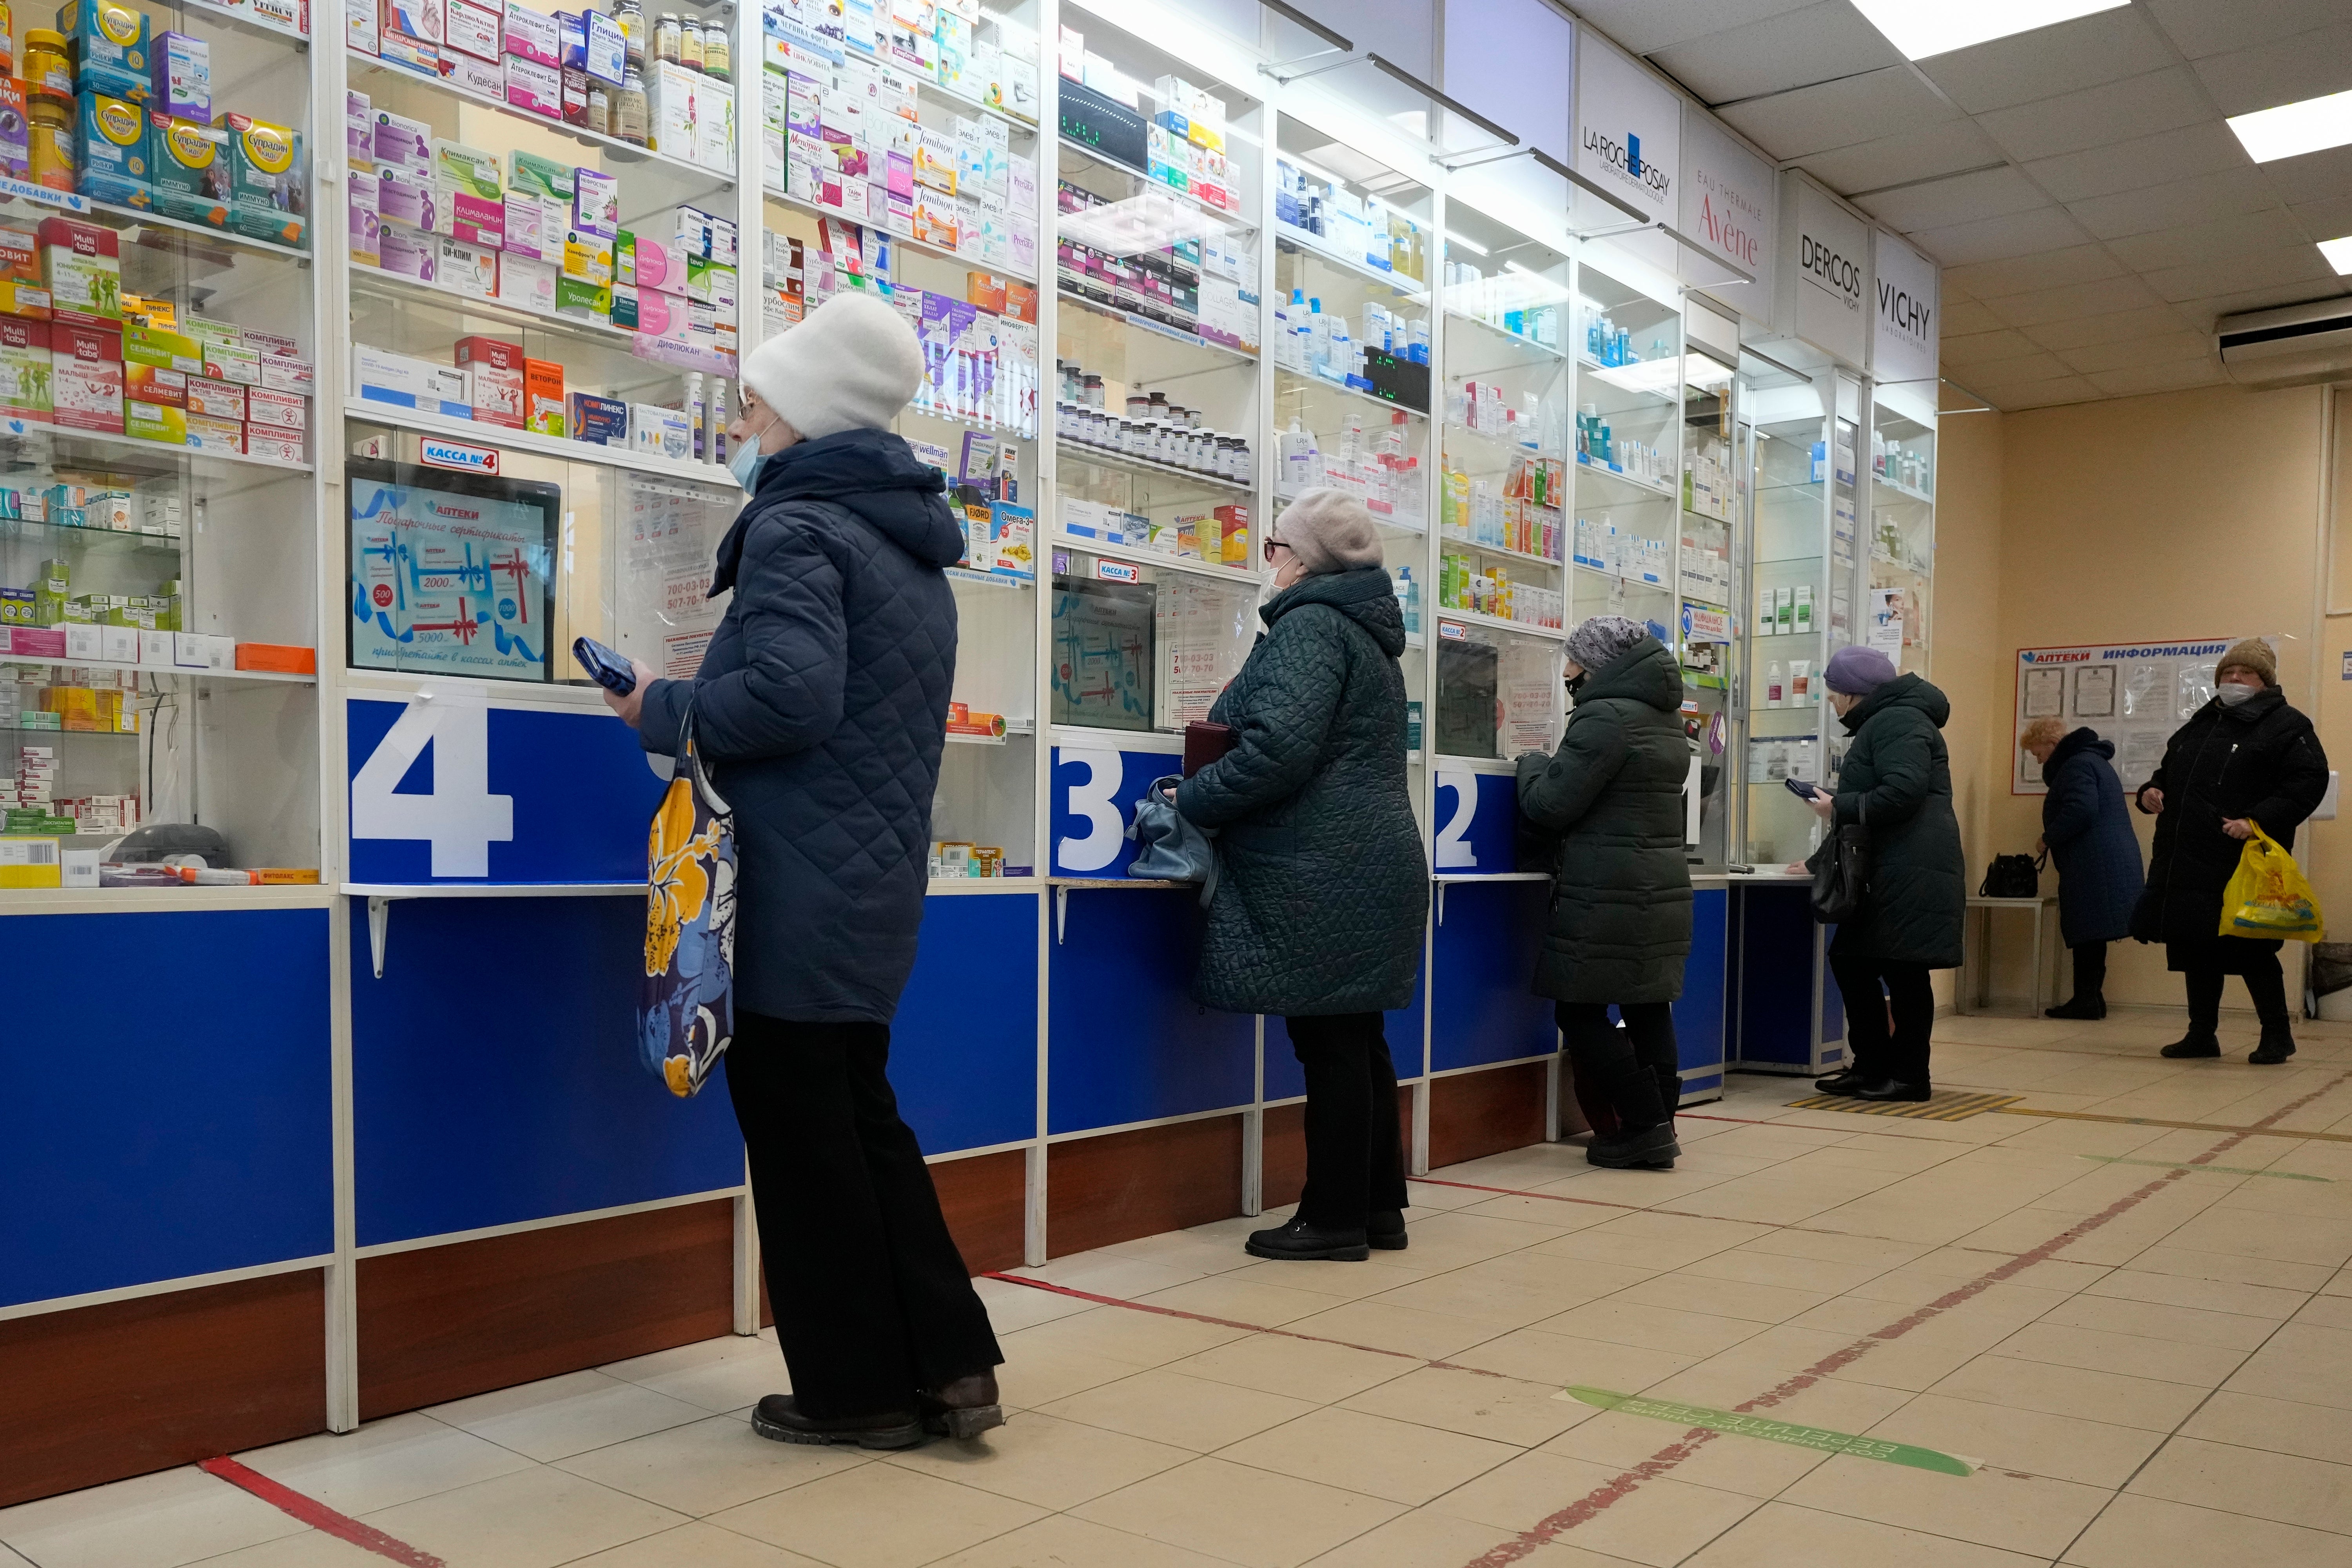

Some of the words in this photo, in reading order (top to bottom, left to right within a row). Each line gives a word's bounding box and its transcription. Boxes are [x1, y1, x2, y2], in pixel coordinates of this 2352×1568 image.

[450, 6, 496, 30] КардиоАктив
[561, 18, 583, 30] Карнитон
[302, 24, 309, 33] 60
[780, 19, 809, 38] ЧЕРНИКА
[810, 31, 830, 47] ФОРТЕ
[384, 29, 437, 53] ДИГИДРОКВЕРЦЕТИН
[793, 51, 831, 73] ЦИКЛОВИТА
[894, 47, 916, 63] СуперОптик
[546, 74, 559, 86] Био
[1013, 67, 1029, 80] Vision
[467, 70, 502, 92] Кудесан
[564, 76, 587, 91] Кудесан
[789, 79, 811, 91] МАСТОФИТ
[882, 74, 902, 90] ЦИ-КЛИМ
[100, 109, 138, 129] Супрадин
[390, 119, 418, 132] Bionorica
[172, 130, 211, 152] Супрадин
[247, 134, 288, 154] Супрадин
[789, 132, 823, 153] Menopace
[916, 129, 953, 154] femibion
[440, 146, 485, 166] Климаксан
[1150, 150, 1167, 162] АлфаВит
[1583, 126, 1599, 155] LA
[1600, 136, 1637, 176] ROCHE
[1638, 160, 1670, 196] POSAY
[90, 159, 114, 170] РЫБКИ
[890, 158, 909, 174] МЕНОРИЛ
[160, 178, 191, 192] ИММУНО
[580, 176, 608, 190] НЕФРОСТЕН
[1014, 176, 1034, 192] Prenatal
[1209, 176, 1225, 187] АлфаВит
[1599, 159, 1628, 185] LABORATOIRE
[1627, 176, 1665, 206] DERMATOLOGIQUE
[9, 183, 62, 203] ДОБАВКИ
[848, 187, 862, 197] ТАЙМ
[1697, 170, 1717, 193] EAU
[1719, 183, 1763, 222] THERMALE
[543, 198, 563, 209] Ременс
[687, 213, 710, 226] ФЛЮКОСТАТ
[828, 225, 857, 240] Турбослим
[829, 232, 844, 241] День
[1698, 193, 1759, 267] Avène
[73, 232, 95, 245] Multi
[578, 237, 601, 249] Bionorica
[864, 234, 890, 248] Турбослим
[864, 241, 877, 250] Ночь
[443, 246, 472, 262] ЦИ-КЛИМ
[775, 241, 802, 253] Турбослим
[775, 247, 789, 255] Кофе
[1343, 245, 1363, 261] URIAGE
[55, 260, 83, 273] ЮНИОР
[690, 257, 704, 267] teva
[1802, 234, 1861, 299] DERCOS
[1086, 269, 1099, 279] Lady's
[1099, 273, 1113, 283] formula
[978, 281, 996, 292] ПРЕГИНОР
[567, 291, 601, 307] Уролесан
[619, 297, 636, 307] Цистон
[895, 292, 906, 300] ТАЙМ
[906, 295, 922, 304] ЭКСПЕРТ
[923, 298, 936, 306] ЦИНК
[1201, 290, 1238, 309] COLLAGEN
[1843, 296, 1860, 313] VICHY
[145, 303, 171, 314] ЛИНЕКС
[774, 307, 800, 320] Капучино
[1181, 304, 1196, 313] formula
[1877, 277, 1931, 341] VICHY
[1000, 319, 1024, 332] ИНОФЕРТ
[1129, 314, 1160, 331] БИОЛОГИЧЕСКИ
[1159, 325, 1180, 338] АКТИВНЫЕ
[1180, 331, 1198, 343] ДОБАВКИ
[75, 339, 98, 352] Multi
[243, 331, 297, 348] КОМПЛИВИТ
[1881, 325, 1926, 354] LABORATOIRES
[129, 343, 171, 359] СЕЛМЕВИТ
[205, 345, 259, 362] КОМПЛИВИТ
[657, 339, 700, 356] ДИФЛЮКАН
[491, 350, 507, 361] Multi
[261, 356, 314, 373] КОМПЛИВИТ
[530, 373, 561, 387] ВЕТОРОН
[143, 384, 183, 399] СЕЛМЕВИТ
[188, 379, 244, 396] КОМПЛИВИТ
[248, 426, 302, 442] КОМПЛИВИТ
[919, 445, 949, 459] wellman
[971, 440, 996, 451] ЭНДОКРИНОЛ
[426, 446, 467, 462] КАССА
[481, 454, 495, 469] 4
[435, 505, 479, 520] АПТЕКИ
[969, 507, 990, 520] FJØRD
[1000, 512, 1030, 526] Омега-3
[1180, 514, 1206, 524] АПТЕКИ
[376, 510, 446, 532] Подарочные
[450, 526, 525, 543] сертификаты
[959, 572, 985, 581] АКТИВНЫЕ
[985, 575, 1008, 585] ДОБАВКИ
[1101, 564, 1123, 577] КАССА
[1130, 568, 1137, 581] 3
[423, 577, 449, 588] 2000
[667, 578, 710, 596] 700-03-03
[374, 589, 390, 599] 500
[1441, 625, 1456, 635] КАССА
[1459, 626, 1465, 637] 2
[1693, 622, 1711, 631] лекарство
[417, 632, 444, 643] 5000
[665, 633, 689, 643] УВАЖАЕМЫЕ
[689, 631, 715, 640] ПОКУПАТЕЛИ!
[372, 646, 448, 662] приобретайте
[451, 652, 458, 662] в
[461, 655, 494, 666] кассах
[497, 657, 528, 668] аптек
[2034, 651, 2091, 663] АПТЕКИ
[2103, 645, 2226, 659] ИНФОРМАЦИЯ
[1694, 703, 1697, 711] 1
[351, 683, 514, 877] 4
[1058, 736, 1125, 871] 3
[1681, 755, 1702, 845] 1
[1435, 759, 1479, 868] 2
[42, 820, 73, 828] ДЮСПАТАЛИН
[262, 872, 294, 881] ФИТОЛАХС
[1626, 1400, 1715, 1418] СЕБЯ
[1621, 1406, 1749, 1431] ДИСТАНЦИЮ
[1721, 1415, 1898, 1453] БЕРЕГИТЕ
